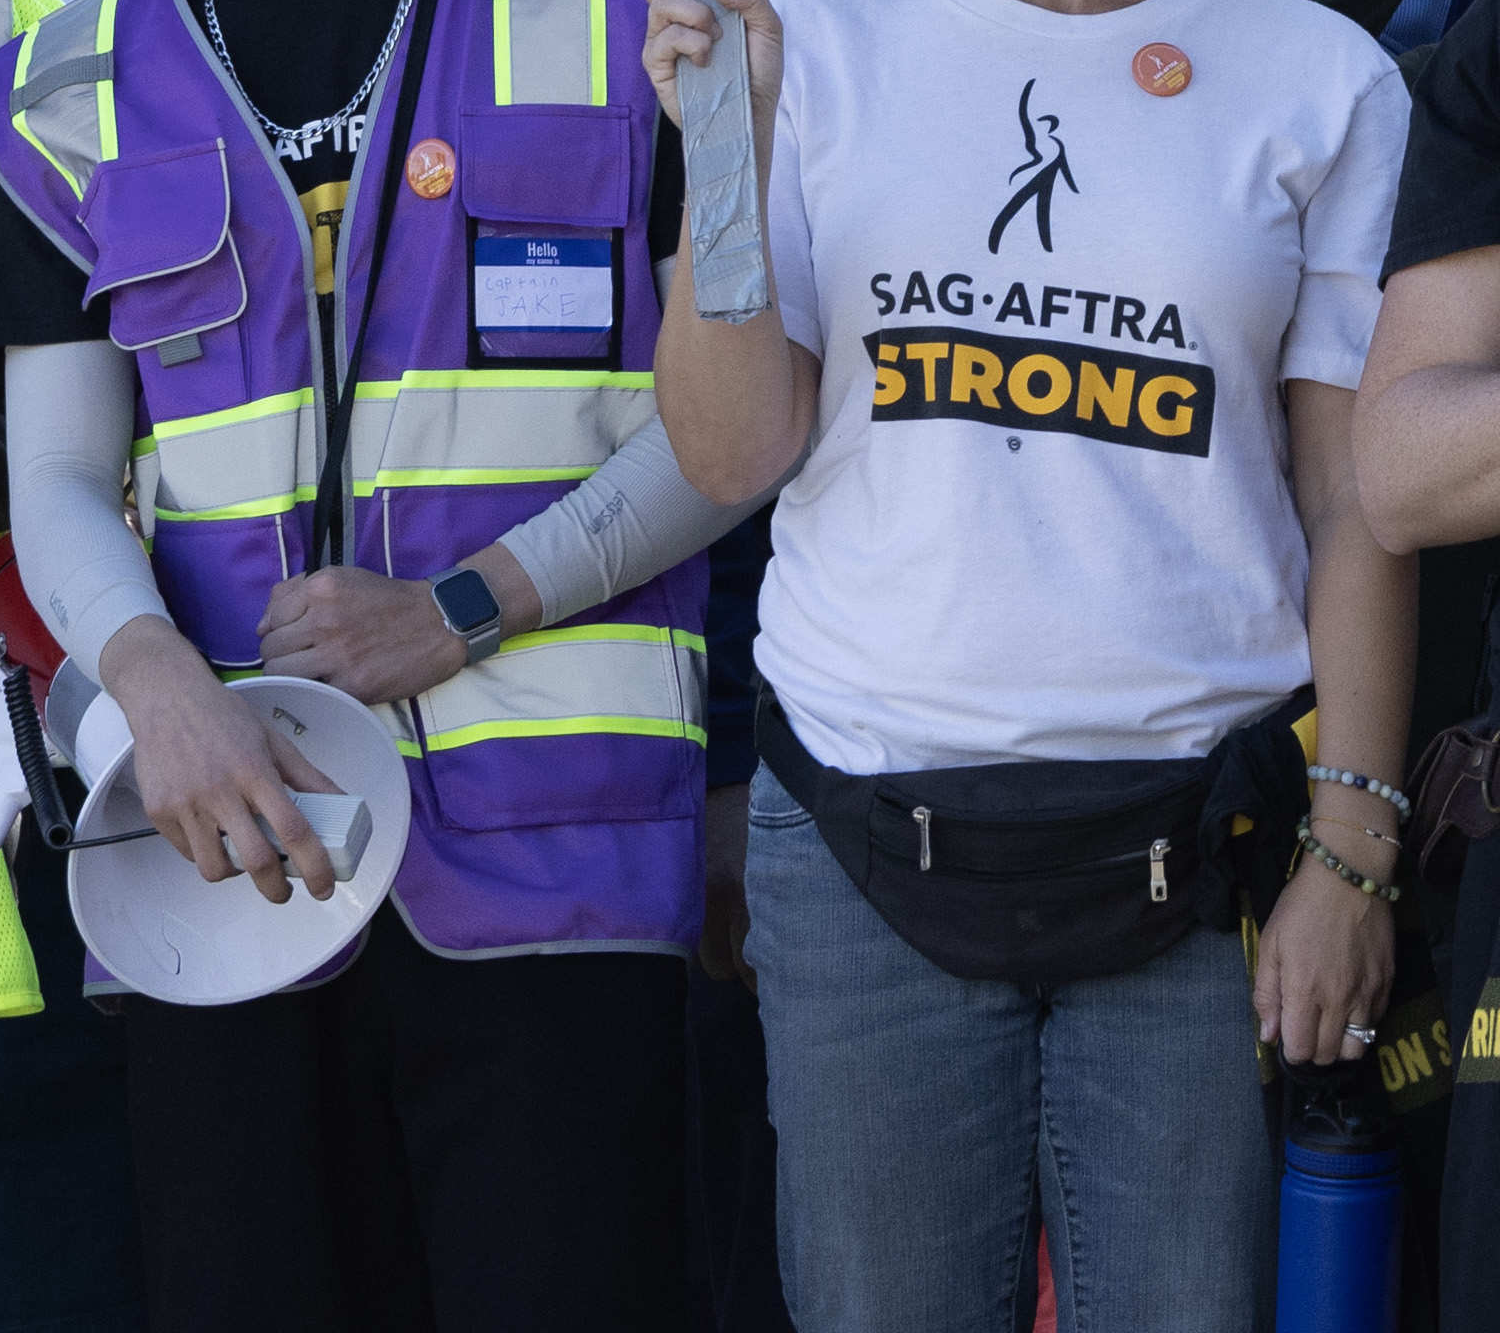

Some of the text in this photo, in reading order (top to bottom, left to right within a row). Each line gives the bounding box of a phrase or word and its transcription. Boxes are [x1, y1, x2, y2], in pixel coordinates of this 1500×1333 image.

[527, 241, 558, 257] Hello
[495, 292, 577, 318] JAKE
[873, 341, 1198, 437] STRONG
